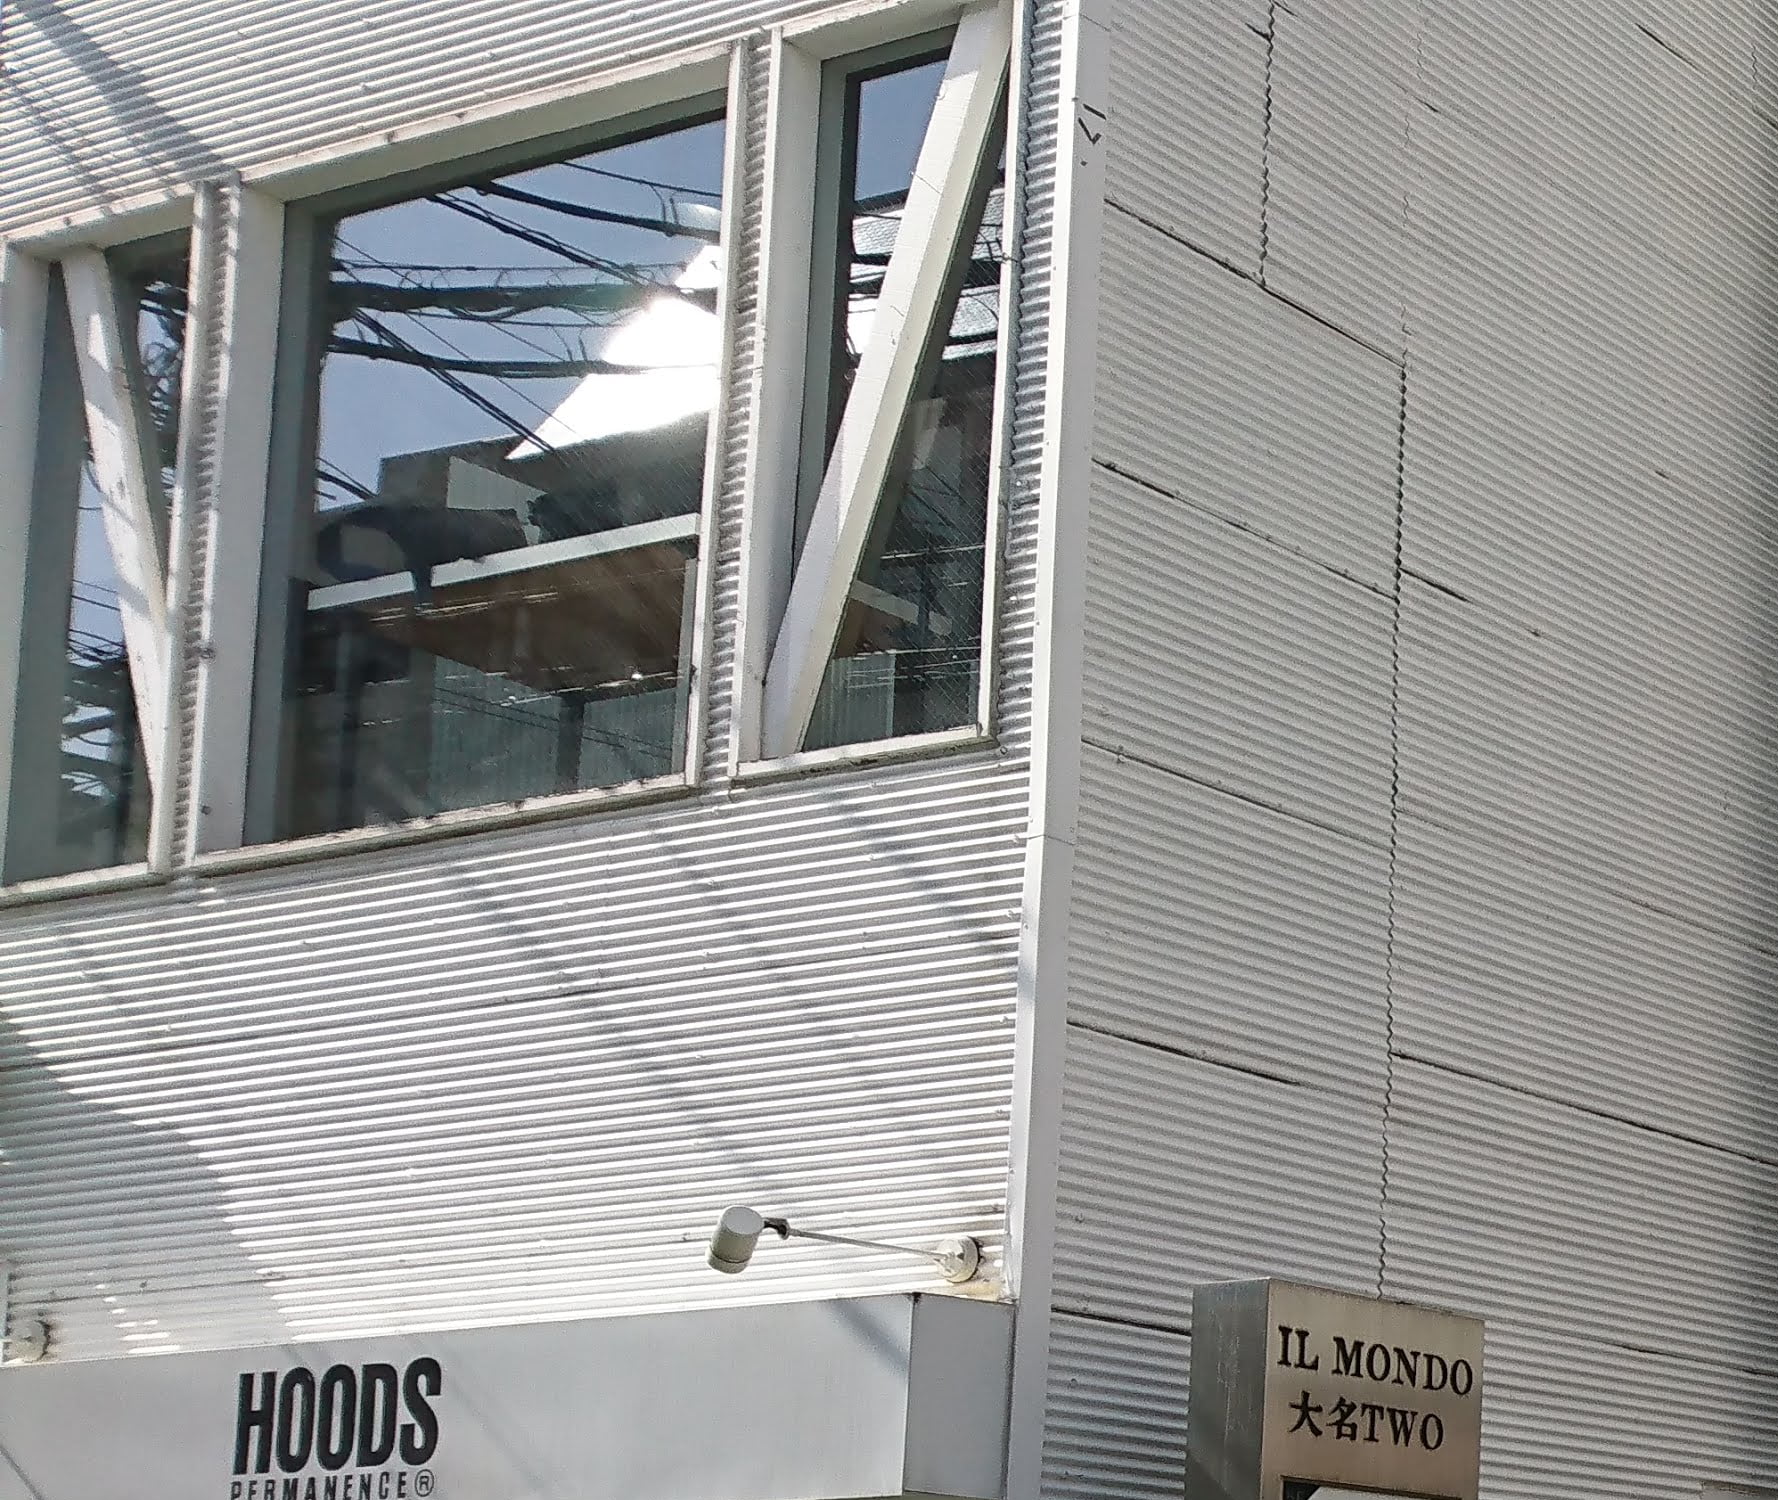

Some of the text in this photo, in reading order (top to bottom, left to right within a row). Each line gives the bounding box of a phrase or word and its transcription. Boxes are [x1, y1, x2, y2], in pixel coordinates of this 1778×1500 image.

[1277, 1324, 1474, 1397] IL MONDO
[231, 1356, 442, 1476] HOODS
[1288, 1390, 1445, 1451] 大名TWO
